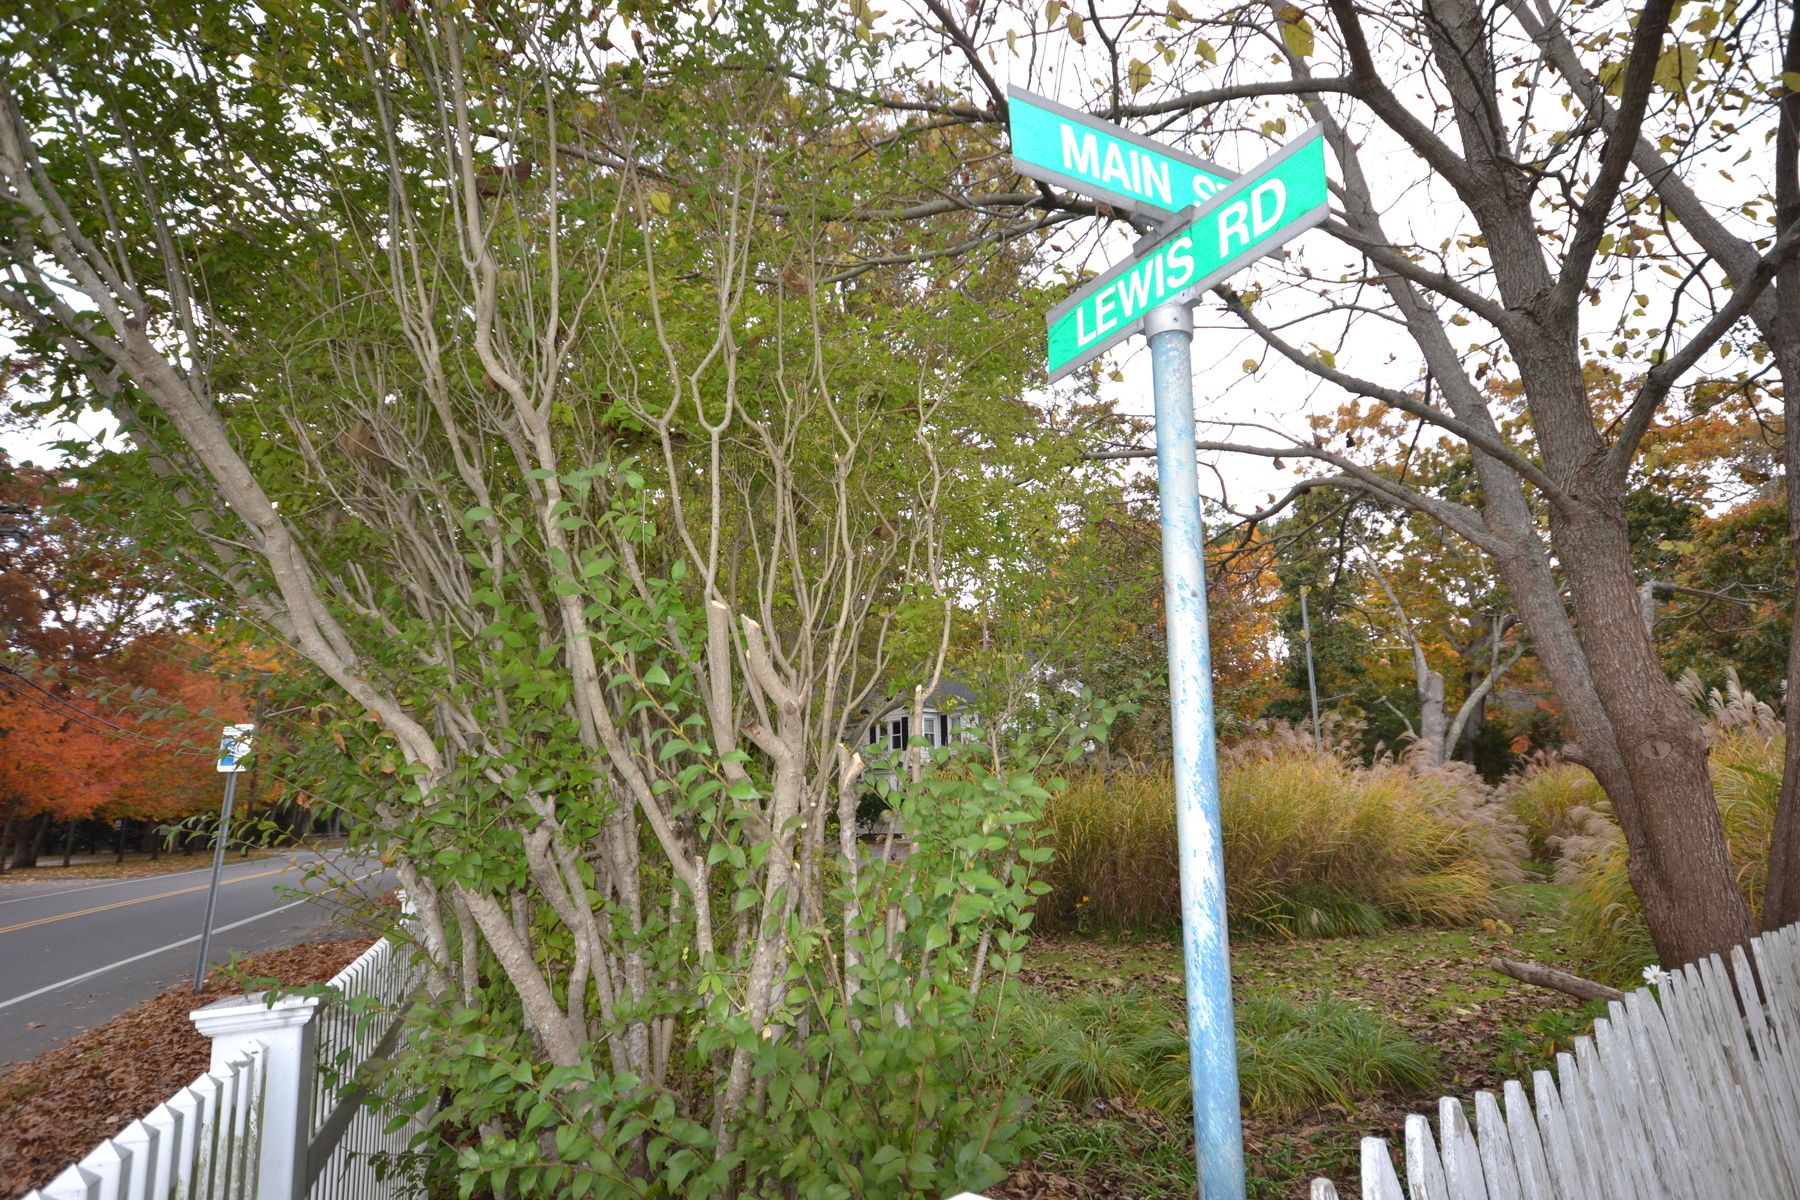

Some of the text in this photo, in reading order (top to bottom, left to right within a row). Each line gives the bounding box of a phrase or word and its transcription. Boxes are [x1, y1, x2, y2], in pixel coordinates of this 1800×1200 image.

[1060, 123, 1228, 207] MAIN S
[1076, 177, 1287, 348] LEWIS RD
